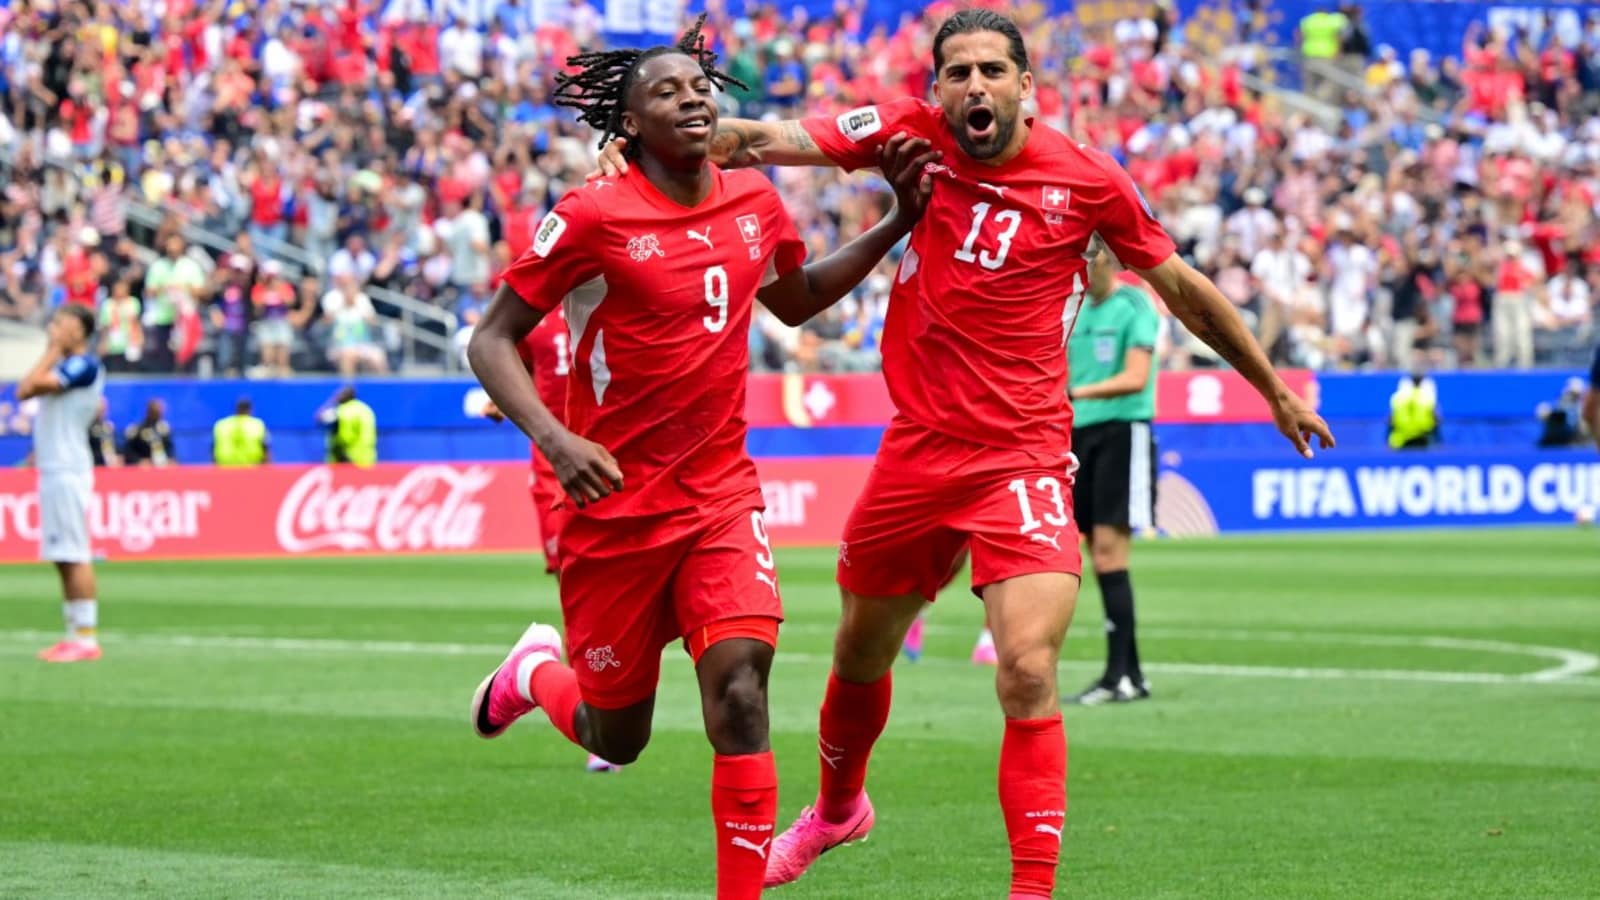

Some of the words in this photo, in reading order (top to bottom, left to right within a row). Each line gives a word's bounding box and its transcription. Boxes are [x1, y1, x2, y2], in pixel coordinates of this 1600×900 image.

[378, 0, 681, 33] ANEES
[953, 202, 1022, 270] 13
[703, 265, 728, 333] 9
[87, 489, 211, 551] ugar
[1008, 476, 1068, 535] 13
[1252, 467, 1357, 519] FIFA
[1356, 464, 1526, 517] WORLD
[751, 510, 774, 570] 9
[1025, 809, 1065, 818] suiss
